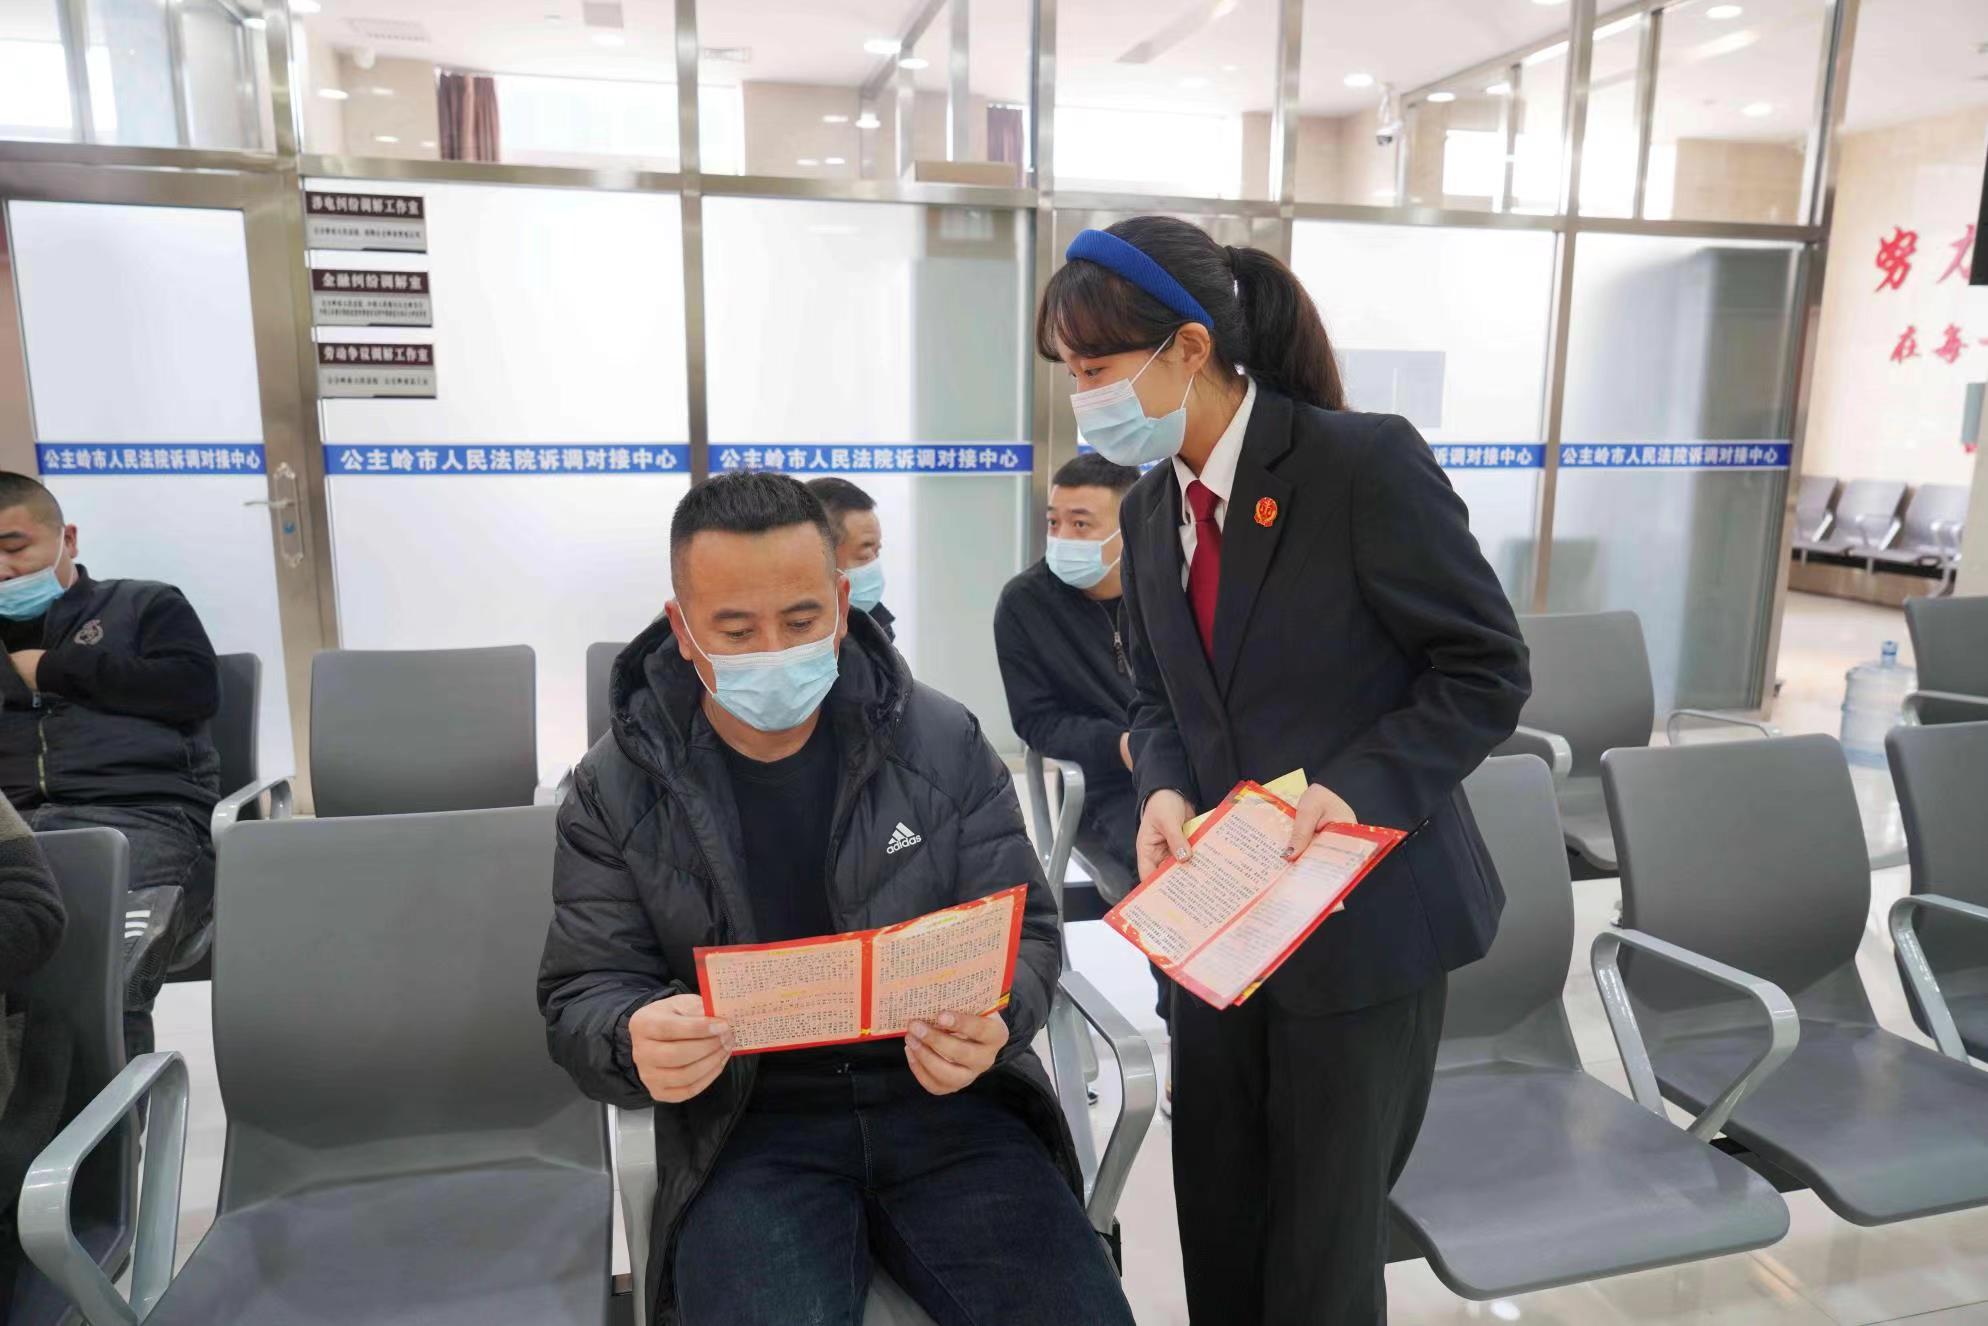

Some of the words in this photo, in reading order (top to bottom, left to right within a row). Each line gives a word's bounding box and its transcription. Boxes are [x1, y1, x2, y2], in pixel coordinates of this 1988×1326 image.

[322, 272, 422, 290] 金融纠纷调解室
[44, 448, 261, 470] 公主岭市人民法院诉调对接中心
[340, 448, 677, 471] 公主岭市人民法院诉调对接中心
[719, 448, 1019, 470] 公主岭市人民法院诉调对接中心
[1562, 446, 1779, 467] 公主岭市人民法院诉调对接中心
[886, 834, 922, 854] adidas
